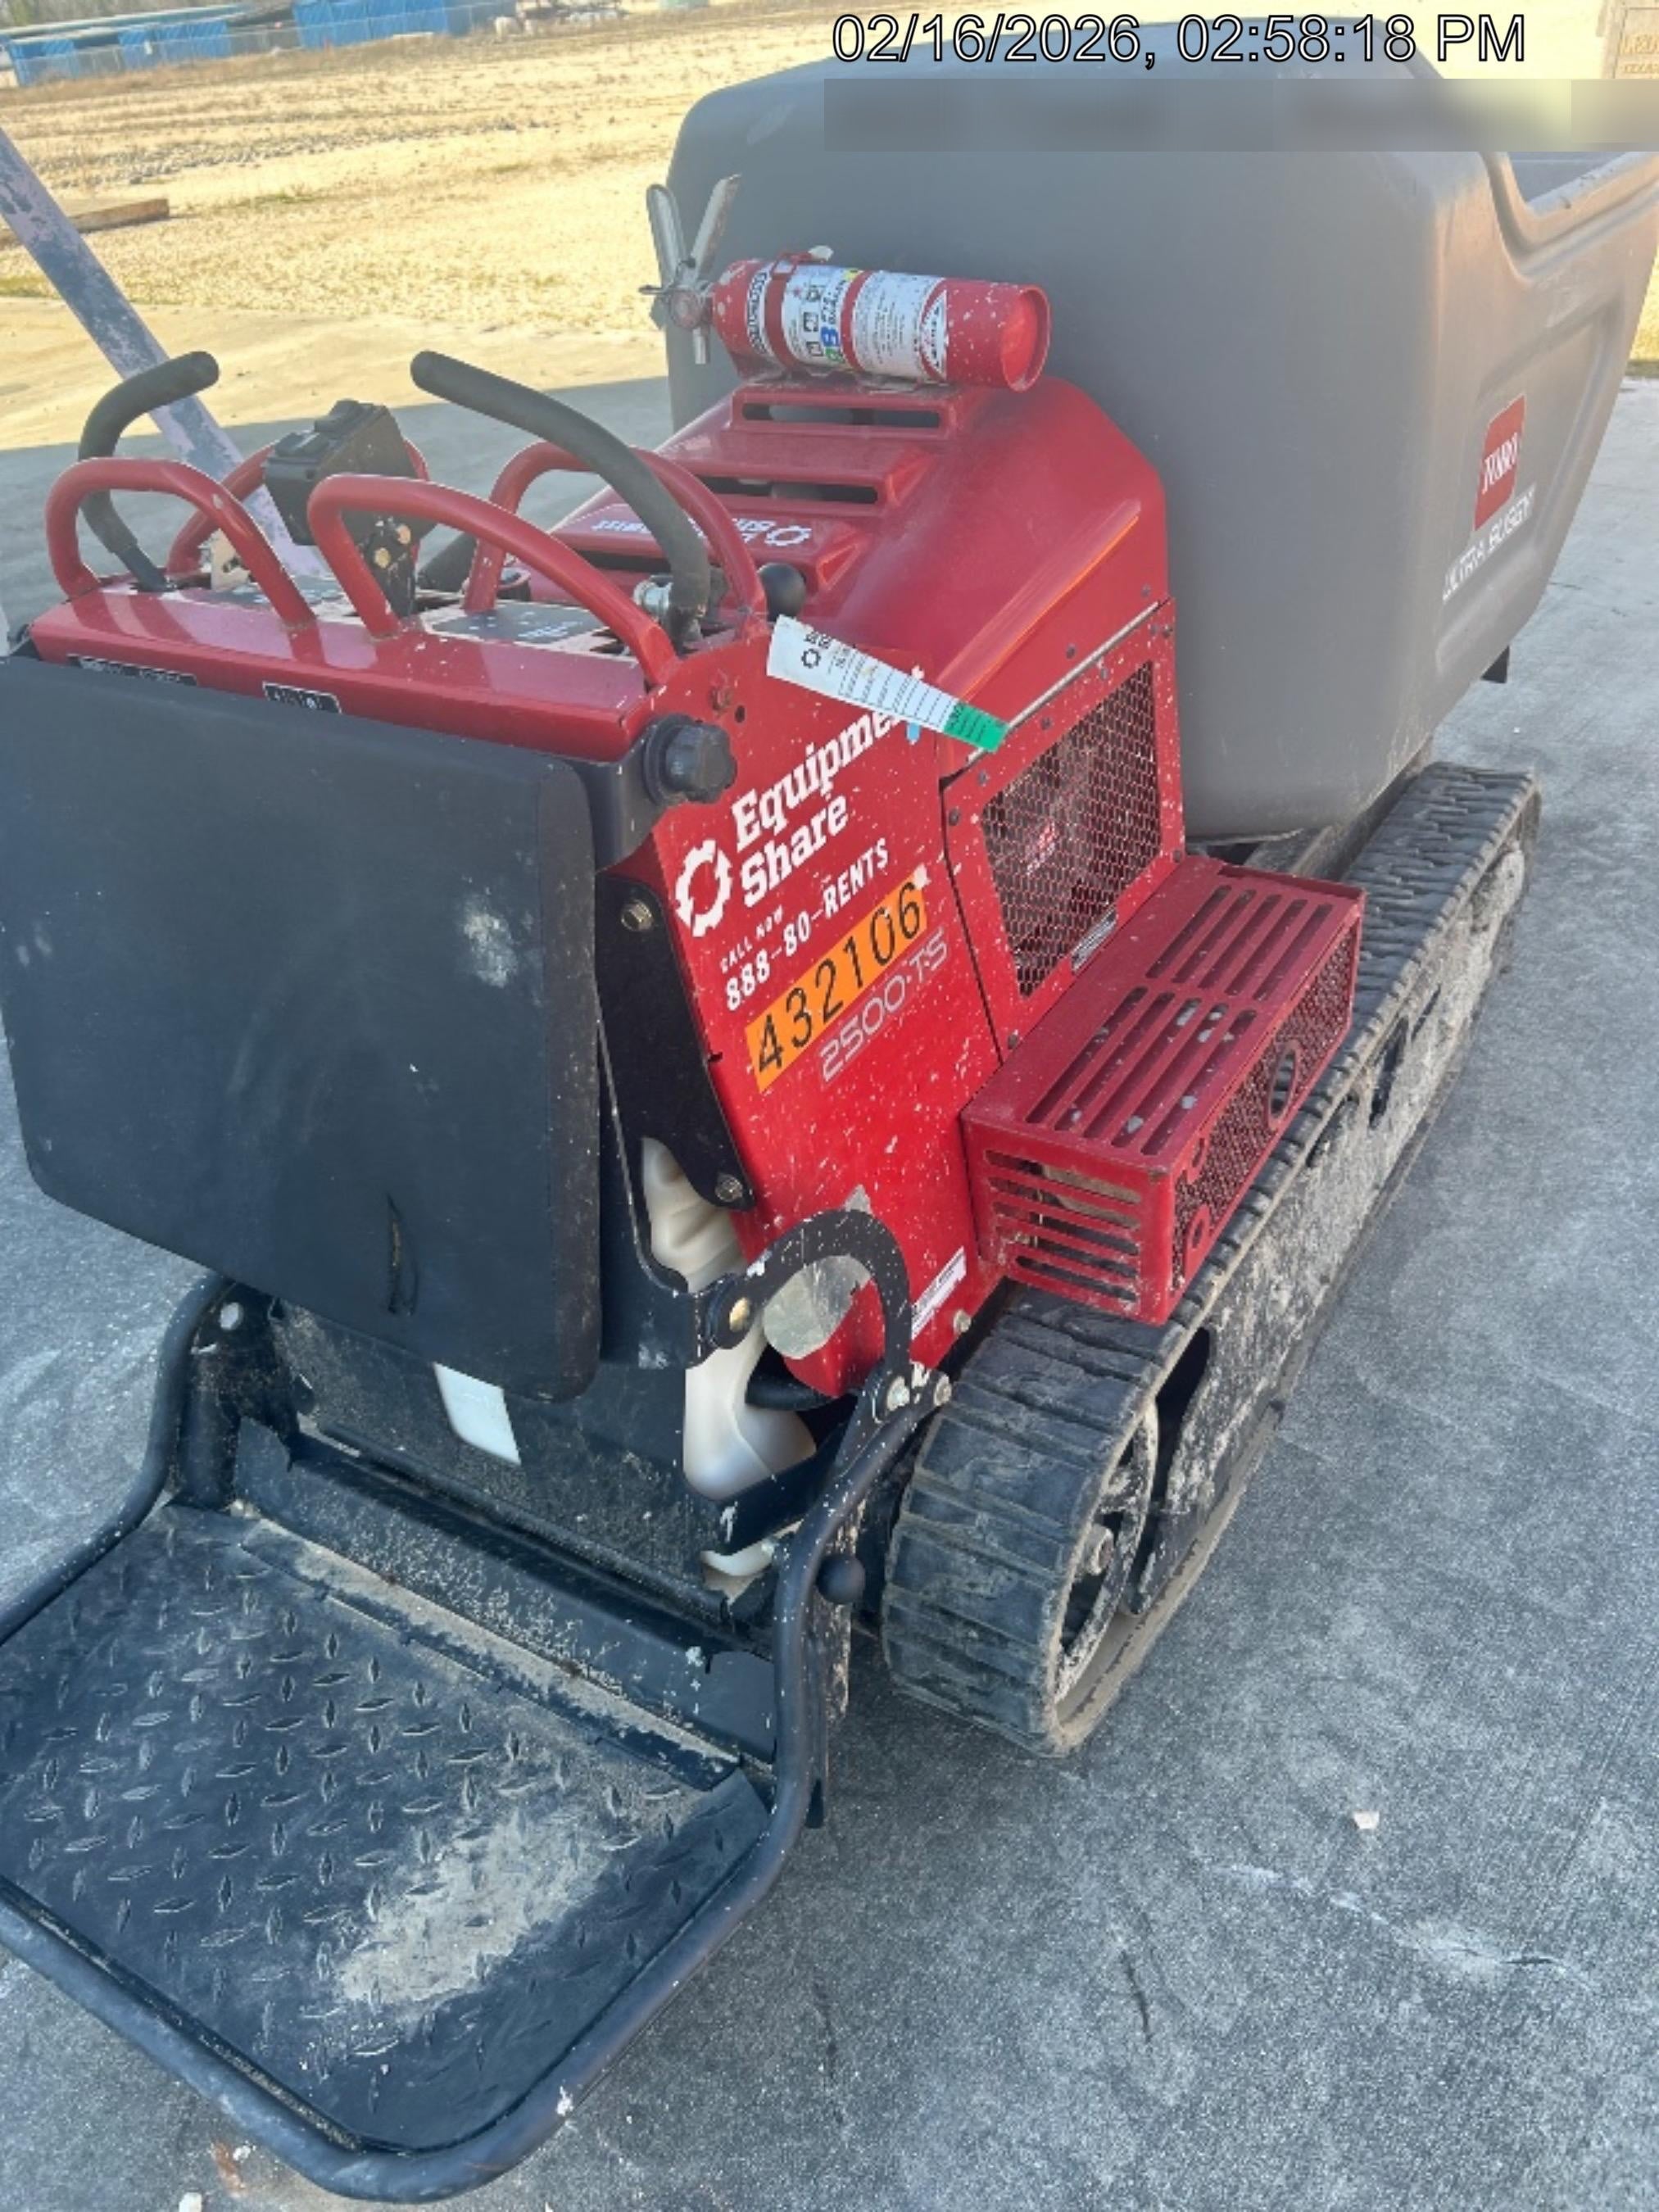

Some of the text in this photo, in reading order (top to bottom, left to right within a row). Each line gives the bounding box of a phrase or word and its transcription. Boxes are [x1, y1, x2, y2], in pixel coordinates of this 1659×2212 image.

[741, 794, 848, 907] Share
[721, 904, 783, 972] CALL NOW
[726, 837, 889, 1010] 888-80-RENTS
[758, 881, 922, 1073] 432106
